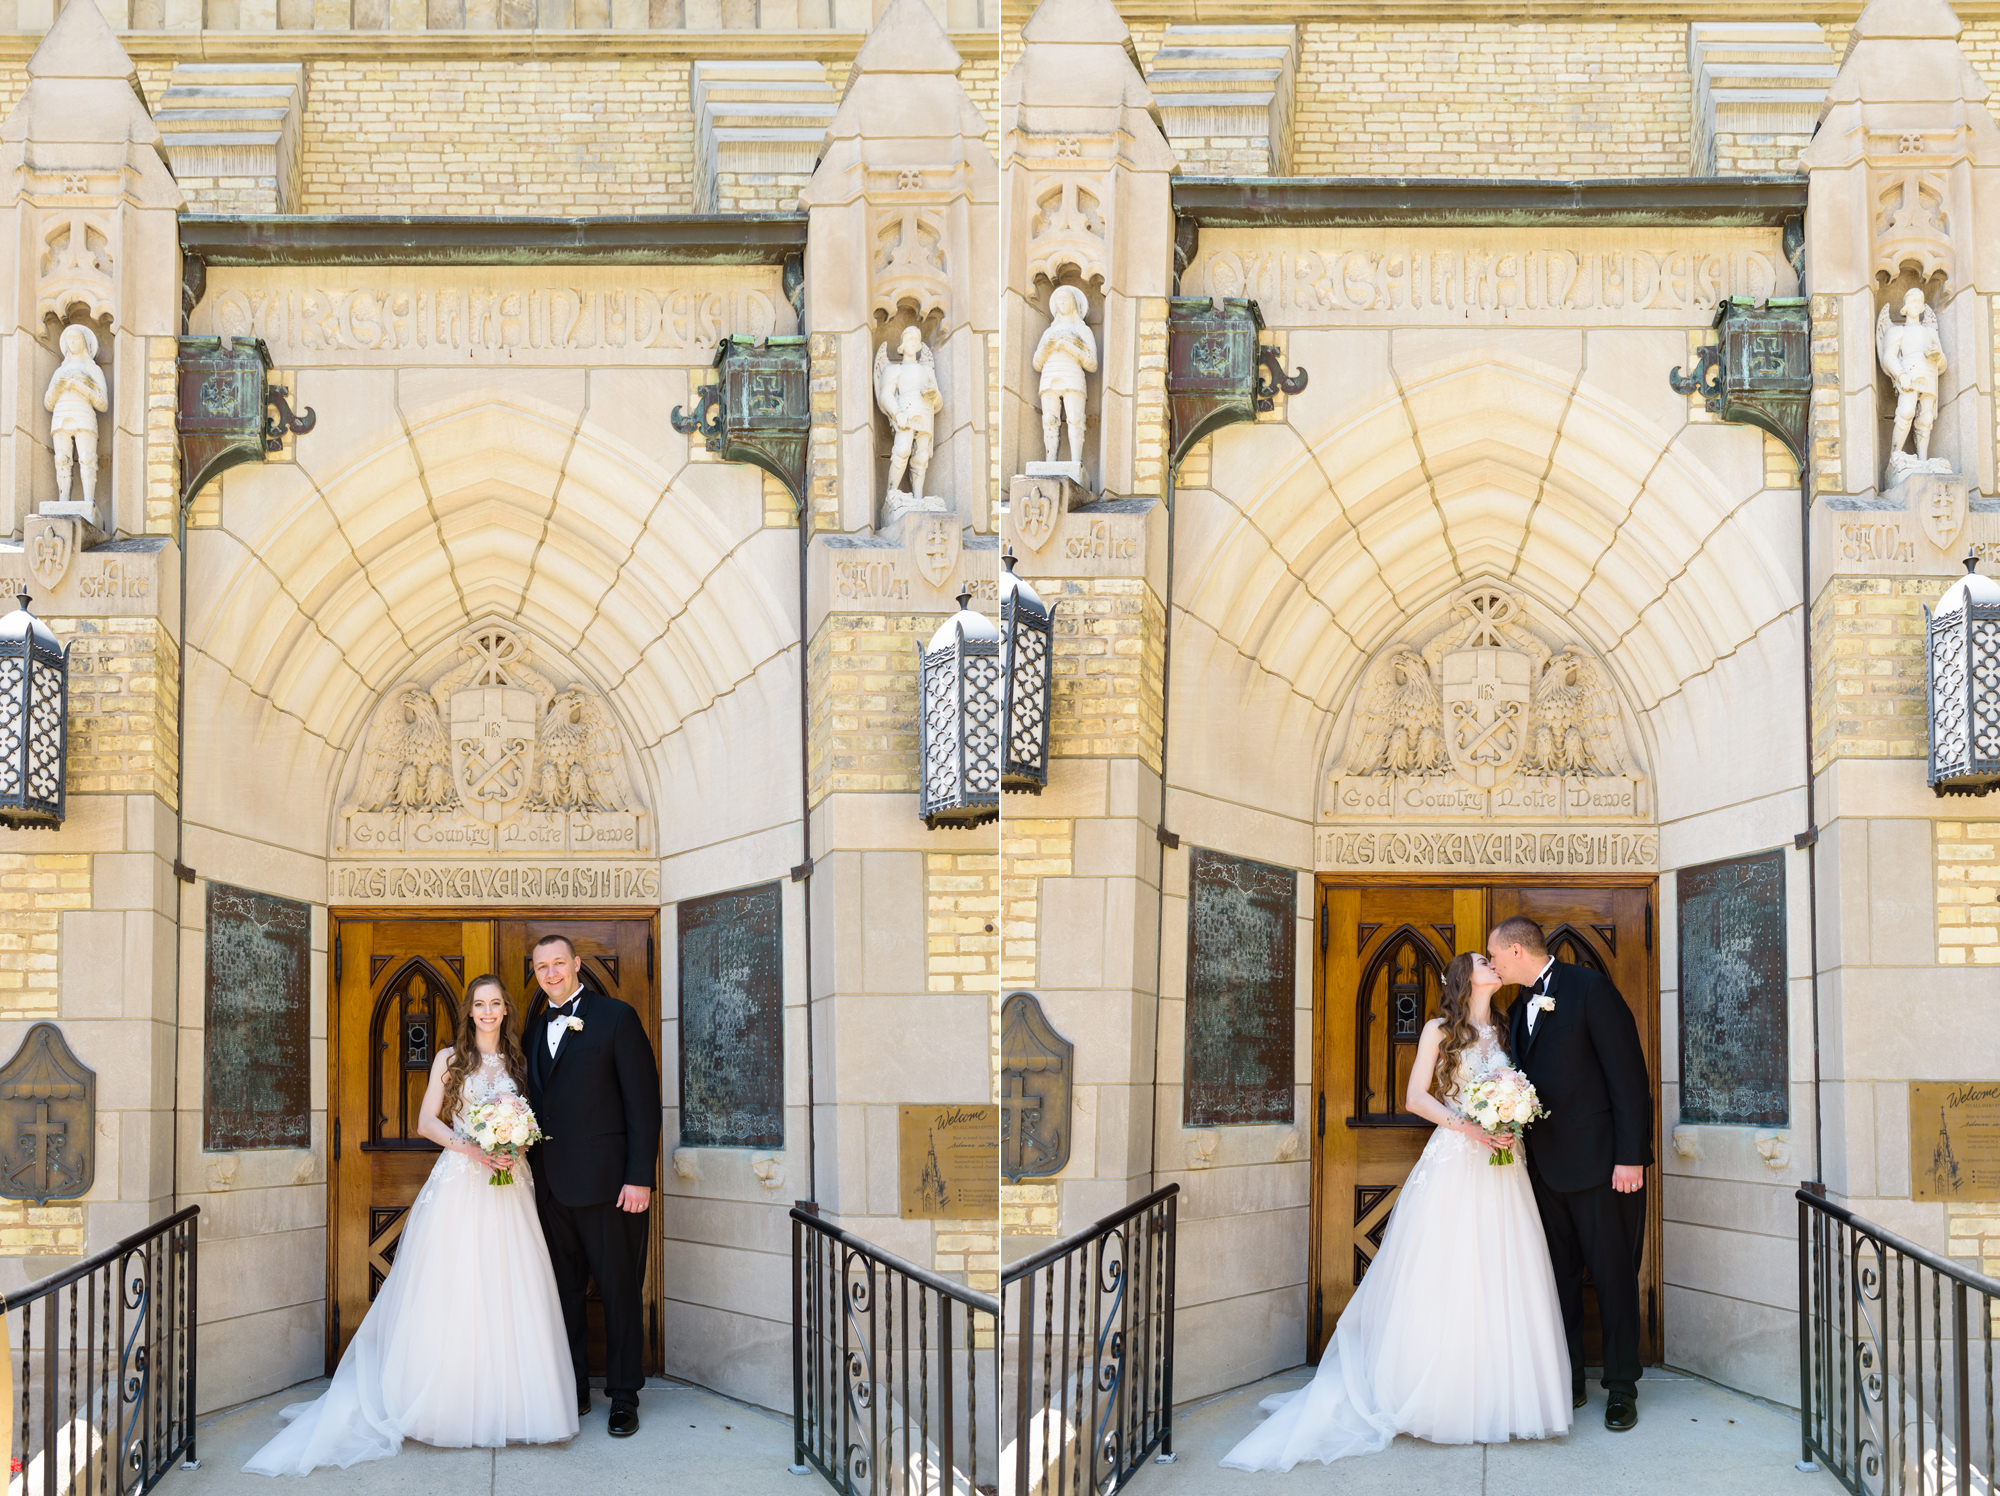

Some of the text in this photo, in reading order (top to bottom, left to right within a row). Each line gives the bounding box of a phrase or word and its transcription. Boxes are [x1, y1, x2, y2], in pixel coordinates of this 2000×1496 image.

[1341, 786, 1631, 811] God Country Notre Dame
[353, 821, 634, 846] God Country Notre Dame
[1947, 1086, 2000, 1108] Welcome
[935, 1109, 987, 1130] Welcome
